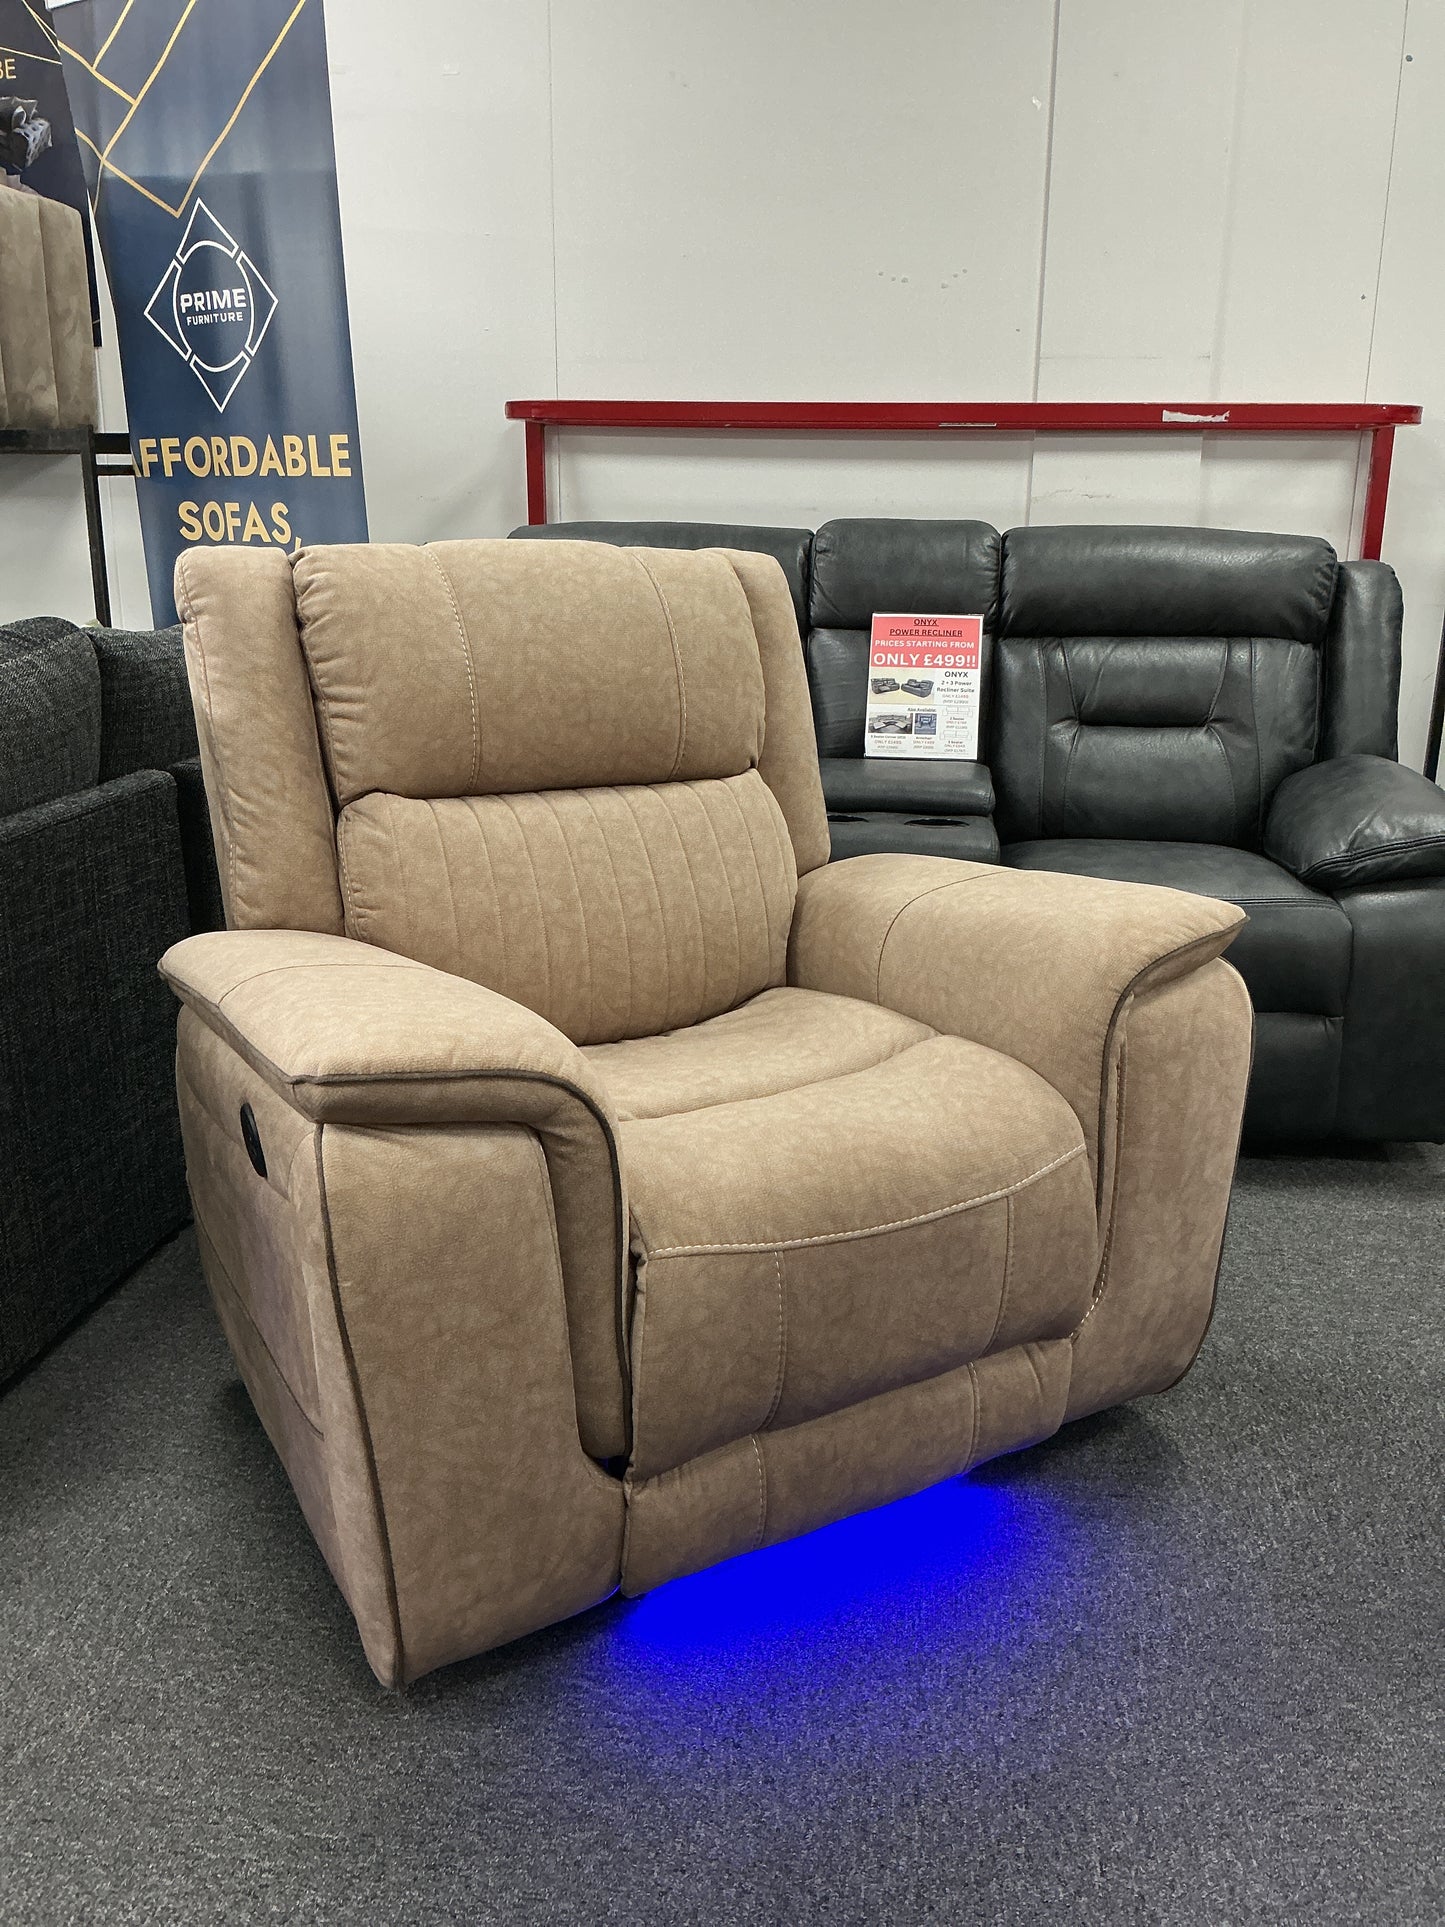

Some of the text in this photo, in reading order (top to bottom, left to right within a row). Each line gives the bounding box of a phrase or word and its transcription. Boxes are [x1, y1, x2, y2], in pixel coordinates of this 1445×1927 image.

[180, 287, 247, 313] PRIME
[186, 311, 244, 326] FURNITURE
[913, 618, 938, 626] ONYX
[889, 628, 963, 637] POWER RECLINER
[875, 639, 975, 649] PRICES STARTING FROM
[873, 653, 976, 667] ONLY £499!!
